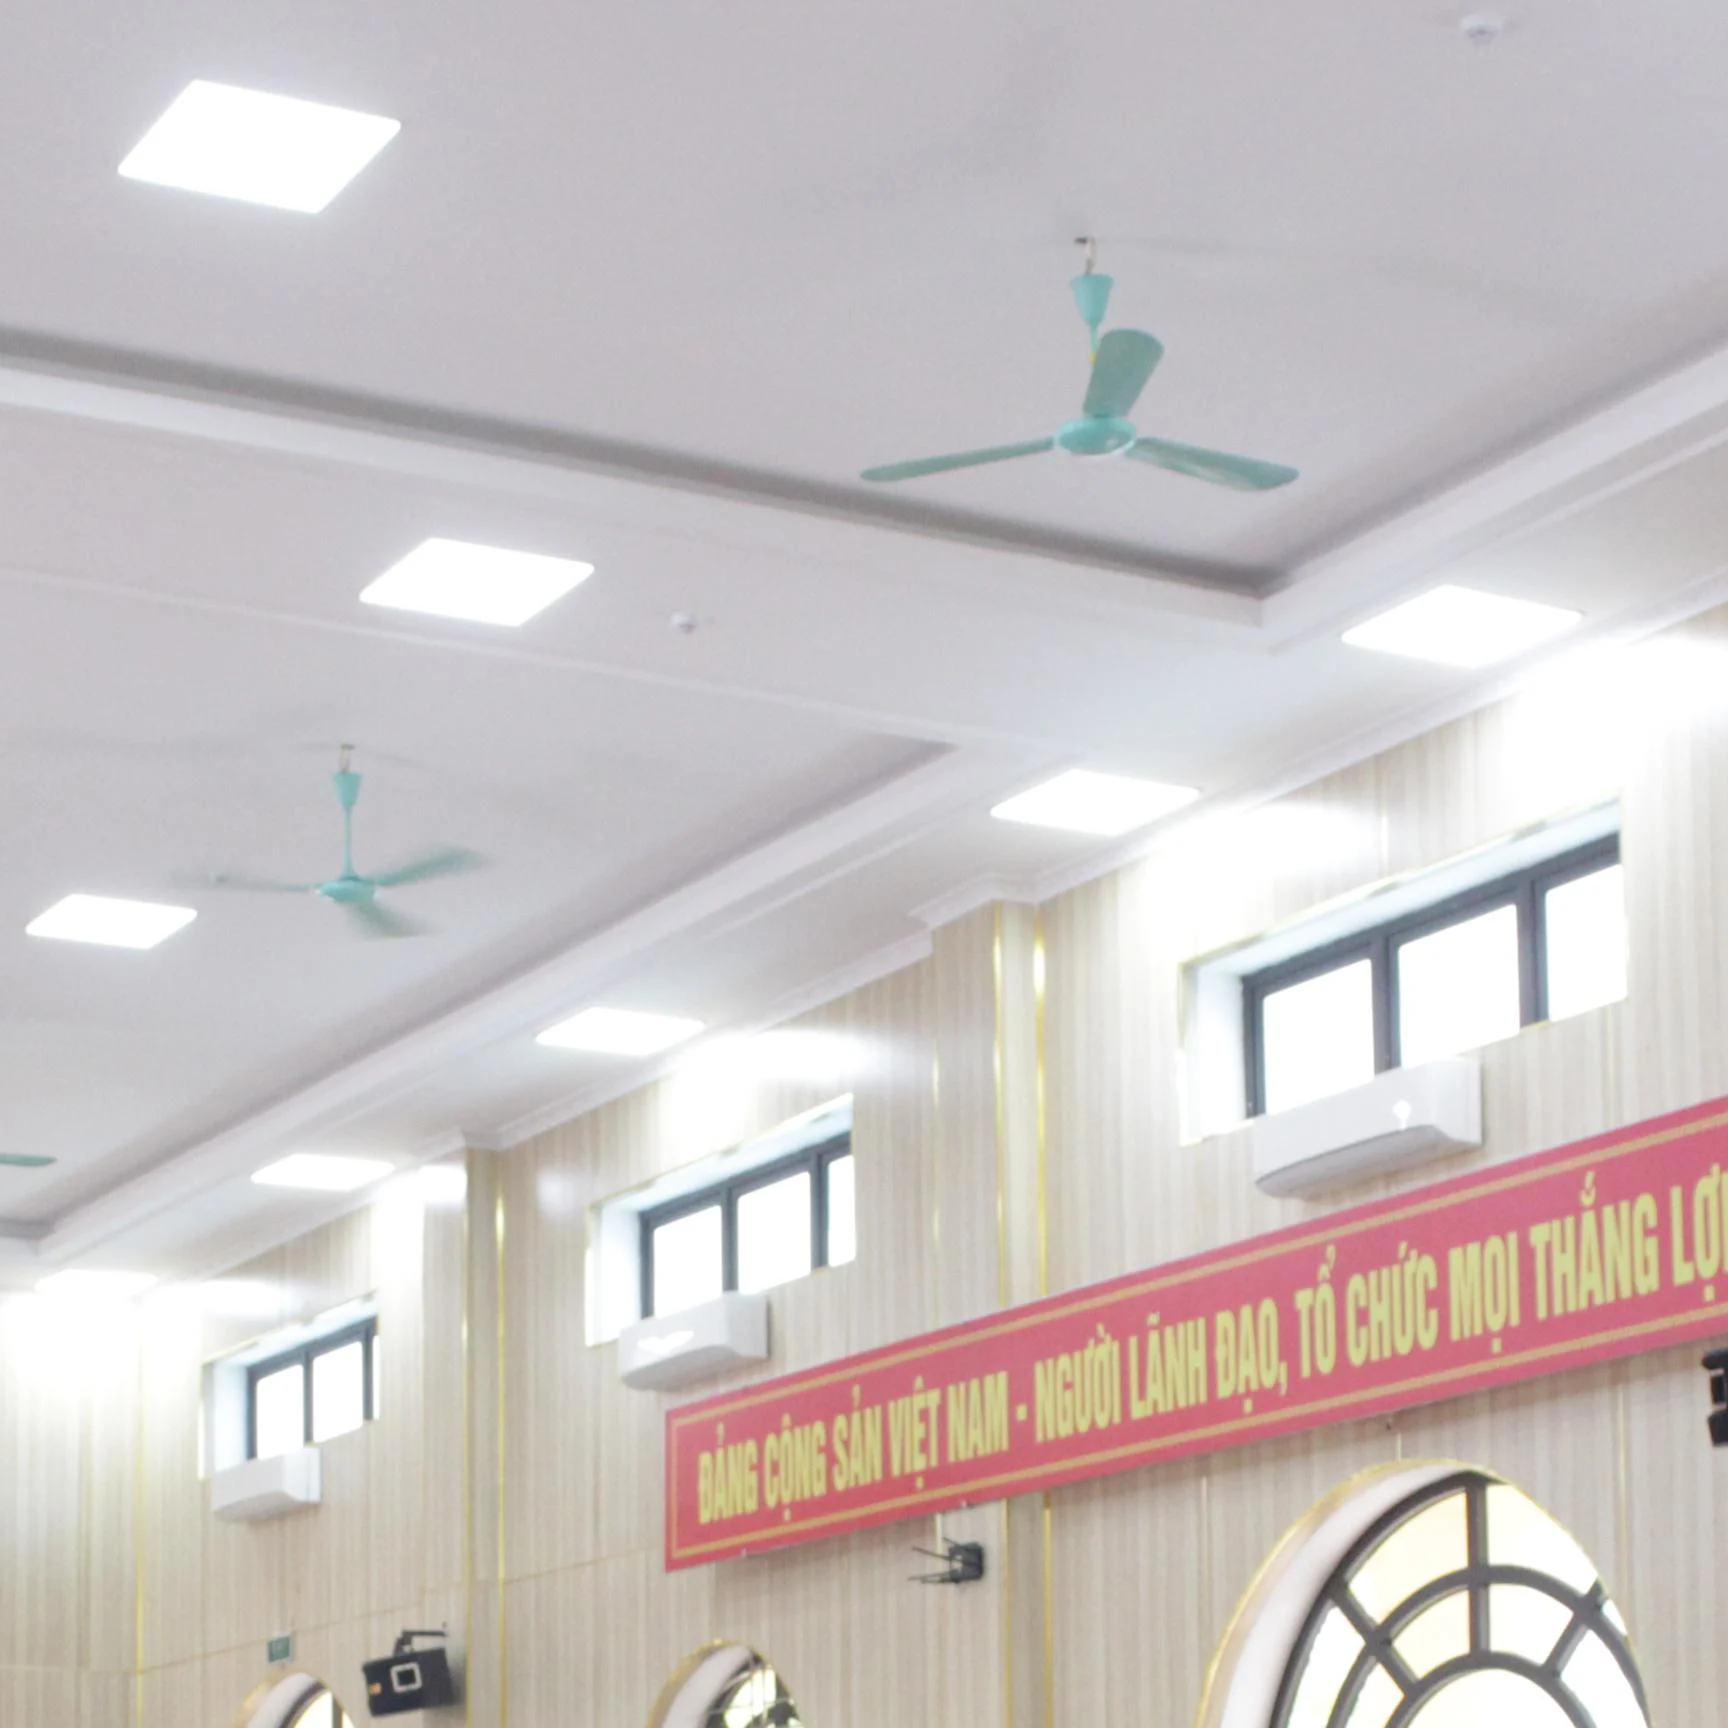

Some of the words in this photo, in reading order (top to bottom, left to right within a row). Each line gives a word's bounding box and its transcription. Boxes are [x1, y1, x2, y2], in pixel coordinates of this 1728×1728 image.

[698, 1423, 758, 1524] ĐẢNG
[764, 1414, 826, 1520] CỘNG
[833, 1385, 882, 1491] SẢN
[889, 1376, 940, 1489] VIỆT
[947, 1371, 1009, 1463] NAM
[1034, 1323, 1120, 1442] NGƯỜI
[1129, 1311, 1206, 1419] LÃNH
[1215, 1297, 1288, 1414] ĐẠO,
[1294, 1245, 1336, 1377] TỔ
[1346, 1241, 1438, 1365] CHỨC
[1450, 1231, 1520, 1353] MỌI
[1530, 1170, 1659, 1320] THẮNG
